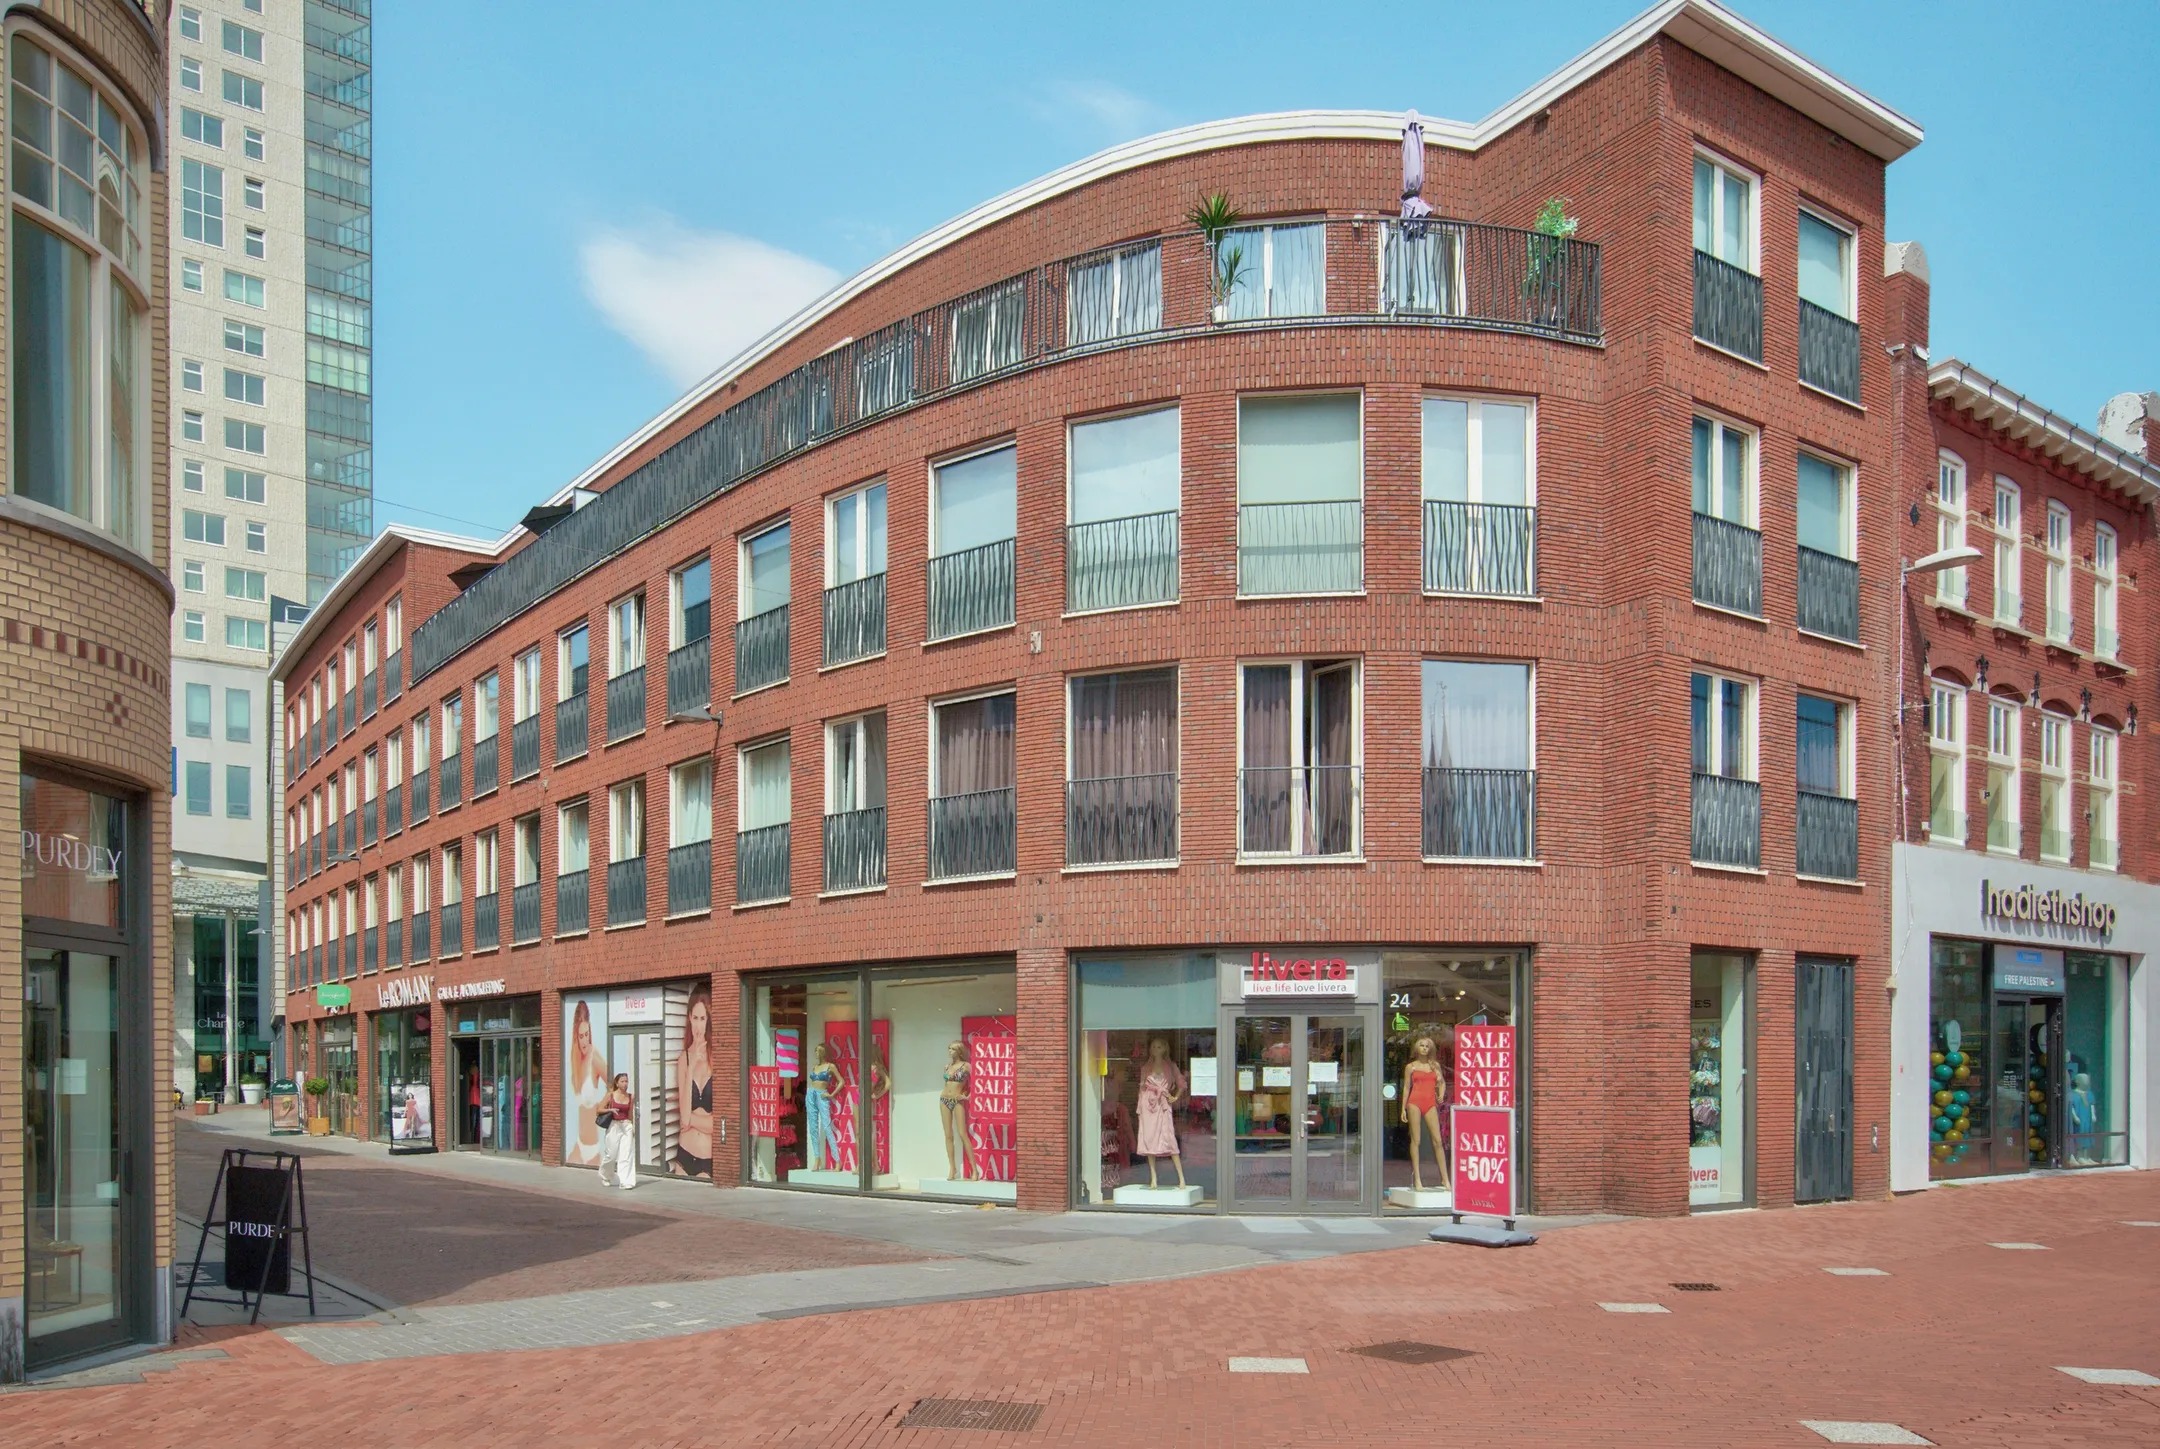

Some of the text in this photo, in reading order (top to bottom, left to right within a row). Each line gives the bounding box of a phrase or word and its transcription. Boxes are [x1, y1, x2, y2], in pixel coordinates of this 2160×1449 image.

[21, 829, 122, 876] PURDEY
[1981, 879, 2117, 937] hadiethshop
[1252, 952, 1347, 981] livera
[1253, 983, 1347, 992] live life love livera
[2004, 974, 2049, 987] FREE PALESTINE
[1390, 993, 1410, 1008] 24
[1691, 999, 1711, 1008] ES
[1460, 1031, 1511, 1049] SALE
[975, 1042, 1015, 1059] SALE
[1460, 1051, 1510, 1068] SALE
[975, 1060, 1014, 1077] SALE
[752, 1071, 778, 1085] SALE
[974, 1078, 1013, 1096] SALE
[1460, 1070, 1510, 1088] SALE
[752, 1087, 777, 1101] SALE
[1459, 1089, 1510, 1107] SALE
[752, 1102, 777, 1116] SALE
[973, 1096, 1013, 1114] SALE
[752, 1117, 777, 1133] SALE
[830, 1118, 885, 1146] SAE
[968, 1122, 1016, 1150] SAL
[1459, 1132, 1506, 1155] SALE
[968, 1153, 1016, 1181] SAL
